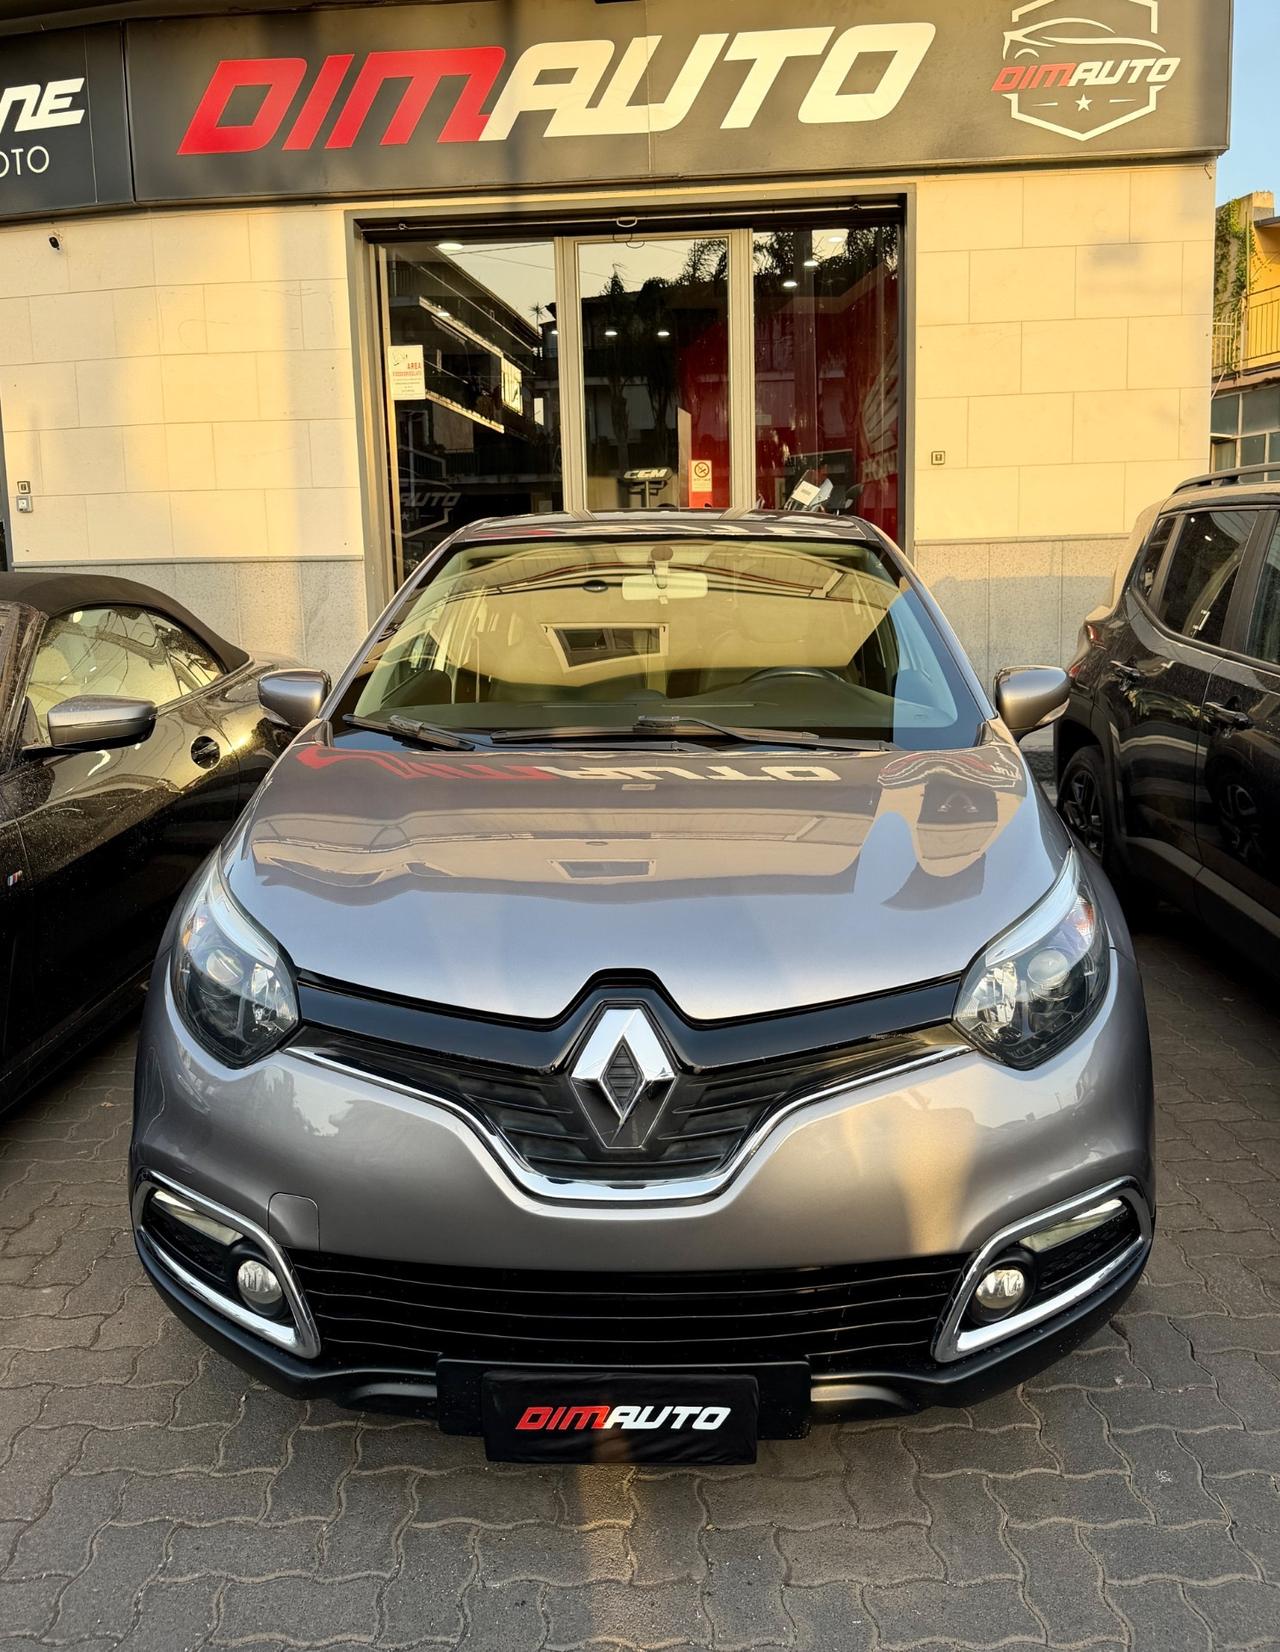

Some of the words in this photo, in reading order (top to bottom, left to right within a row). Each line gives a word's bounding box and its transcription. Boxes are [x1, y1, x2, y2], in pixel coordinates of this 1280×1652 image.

[177, 22, 936, 155] DIMAUTO
[991, 57, 1181, 92] DIMAUTO
[515, 1405, 731, 1430] DIMAUTO
